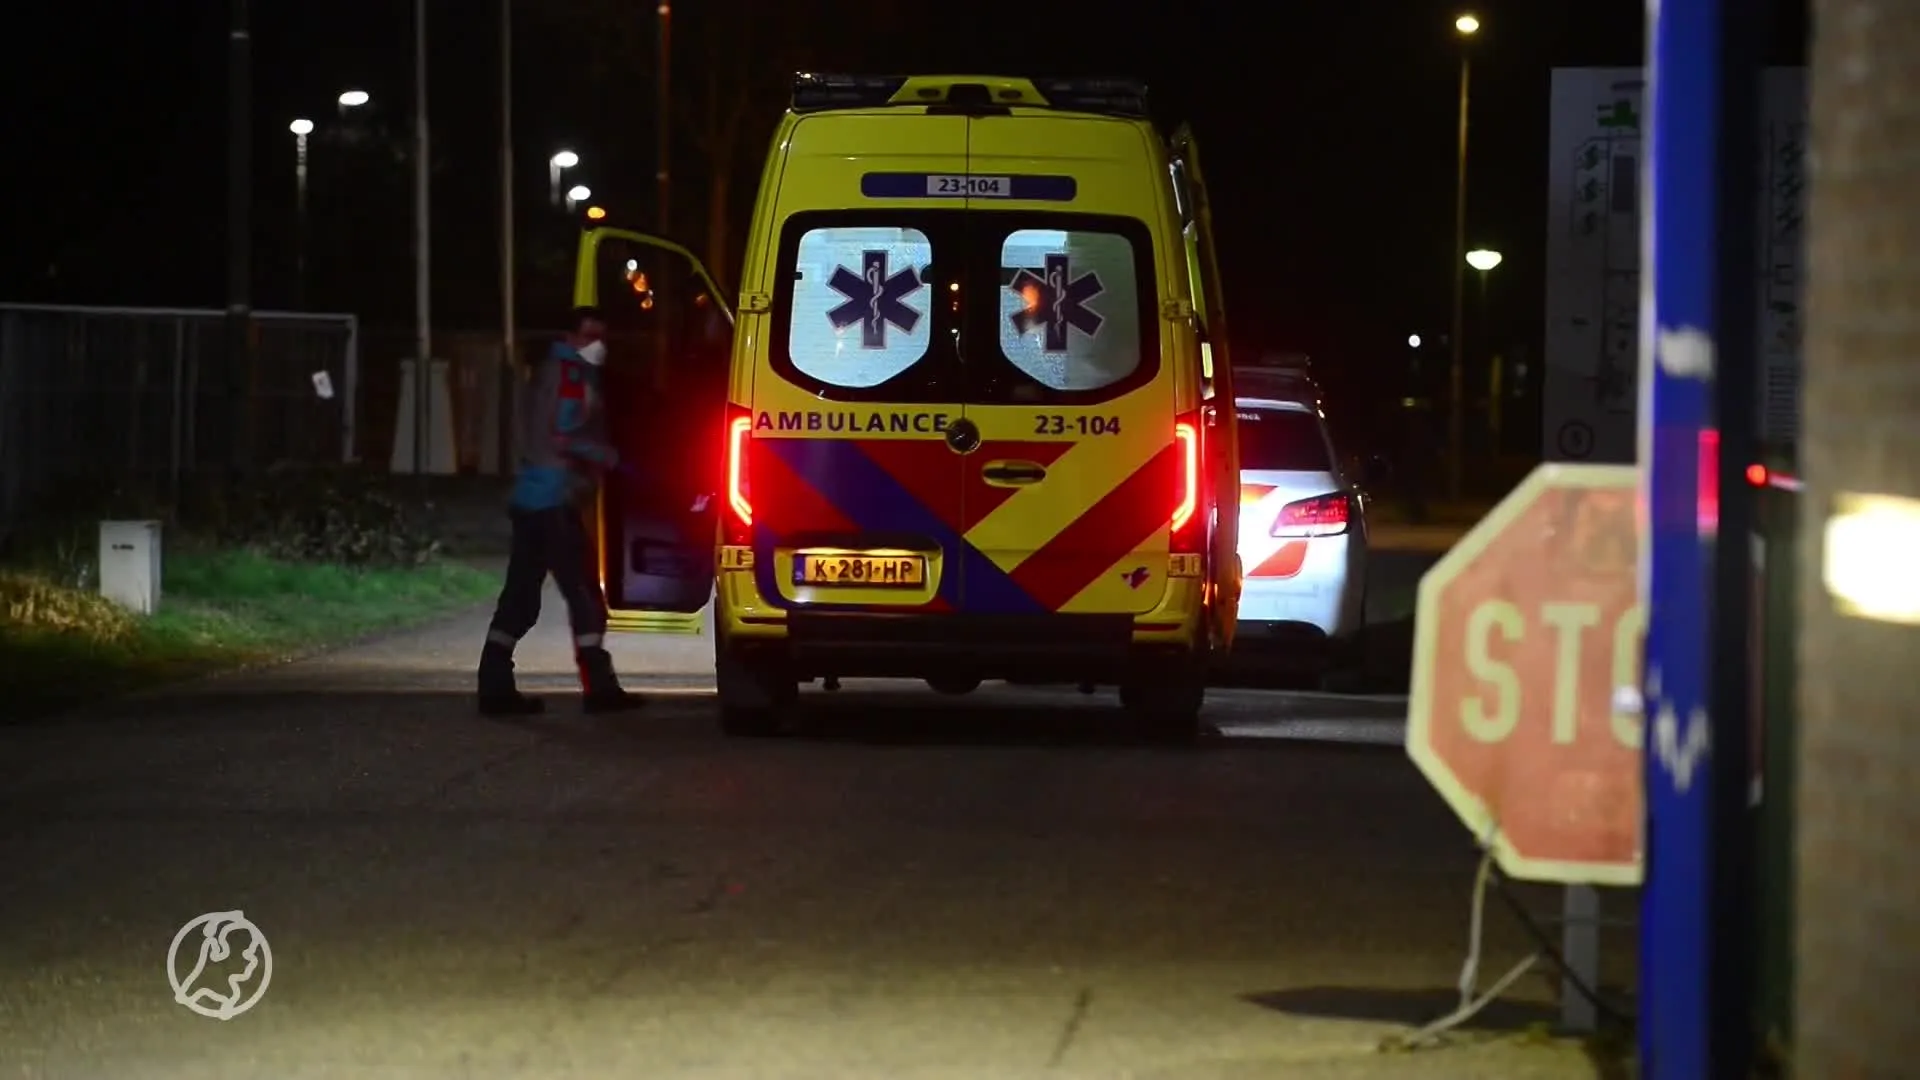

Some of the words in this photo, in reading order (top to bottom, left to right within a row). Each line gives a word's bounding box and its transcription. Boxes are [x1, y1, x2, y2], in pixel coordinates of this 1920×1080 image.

[938, 179, 999, 193] 23-104
[755, 411, 948, 433] AMBULANCE
[1034, 414, 1121, 435] 23-104
